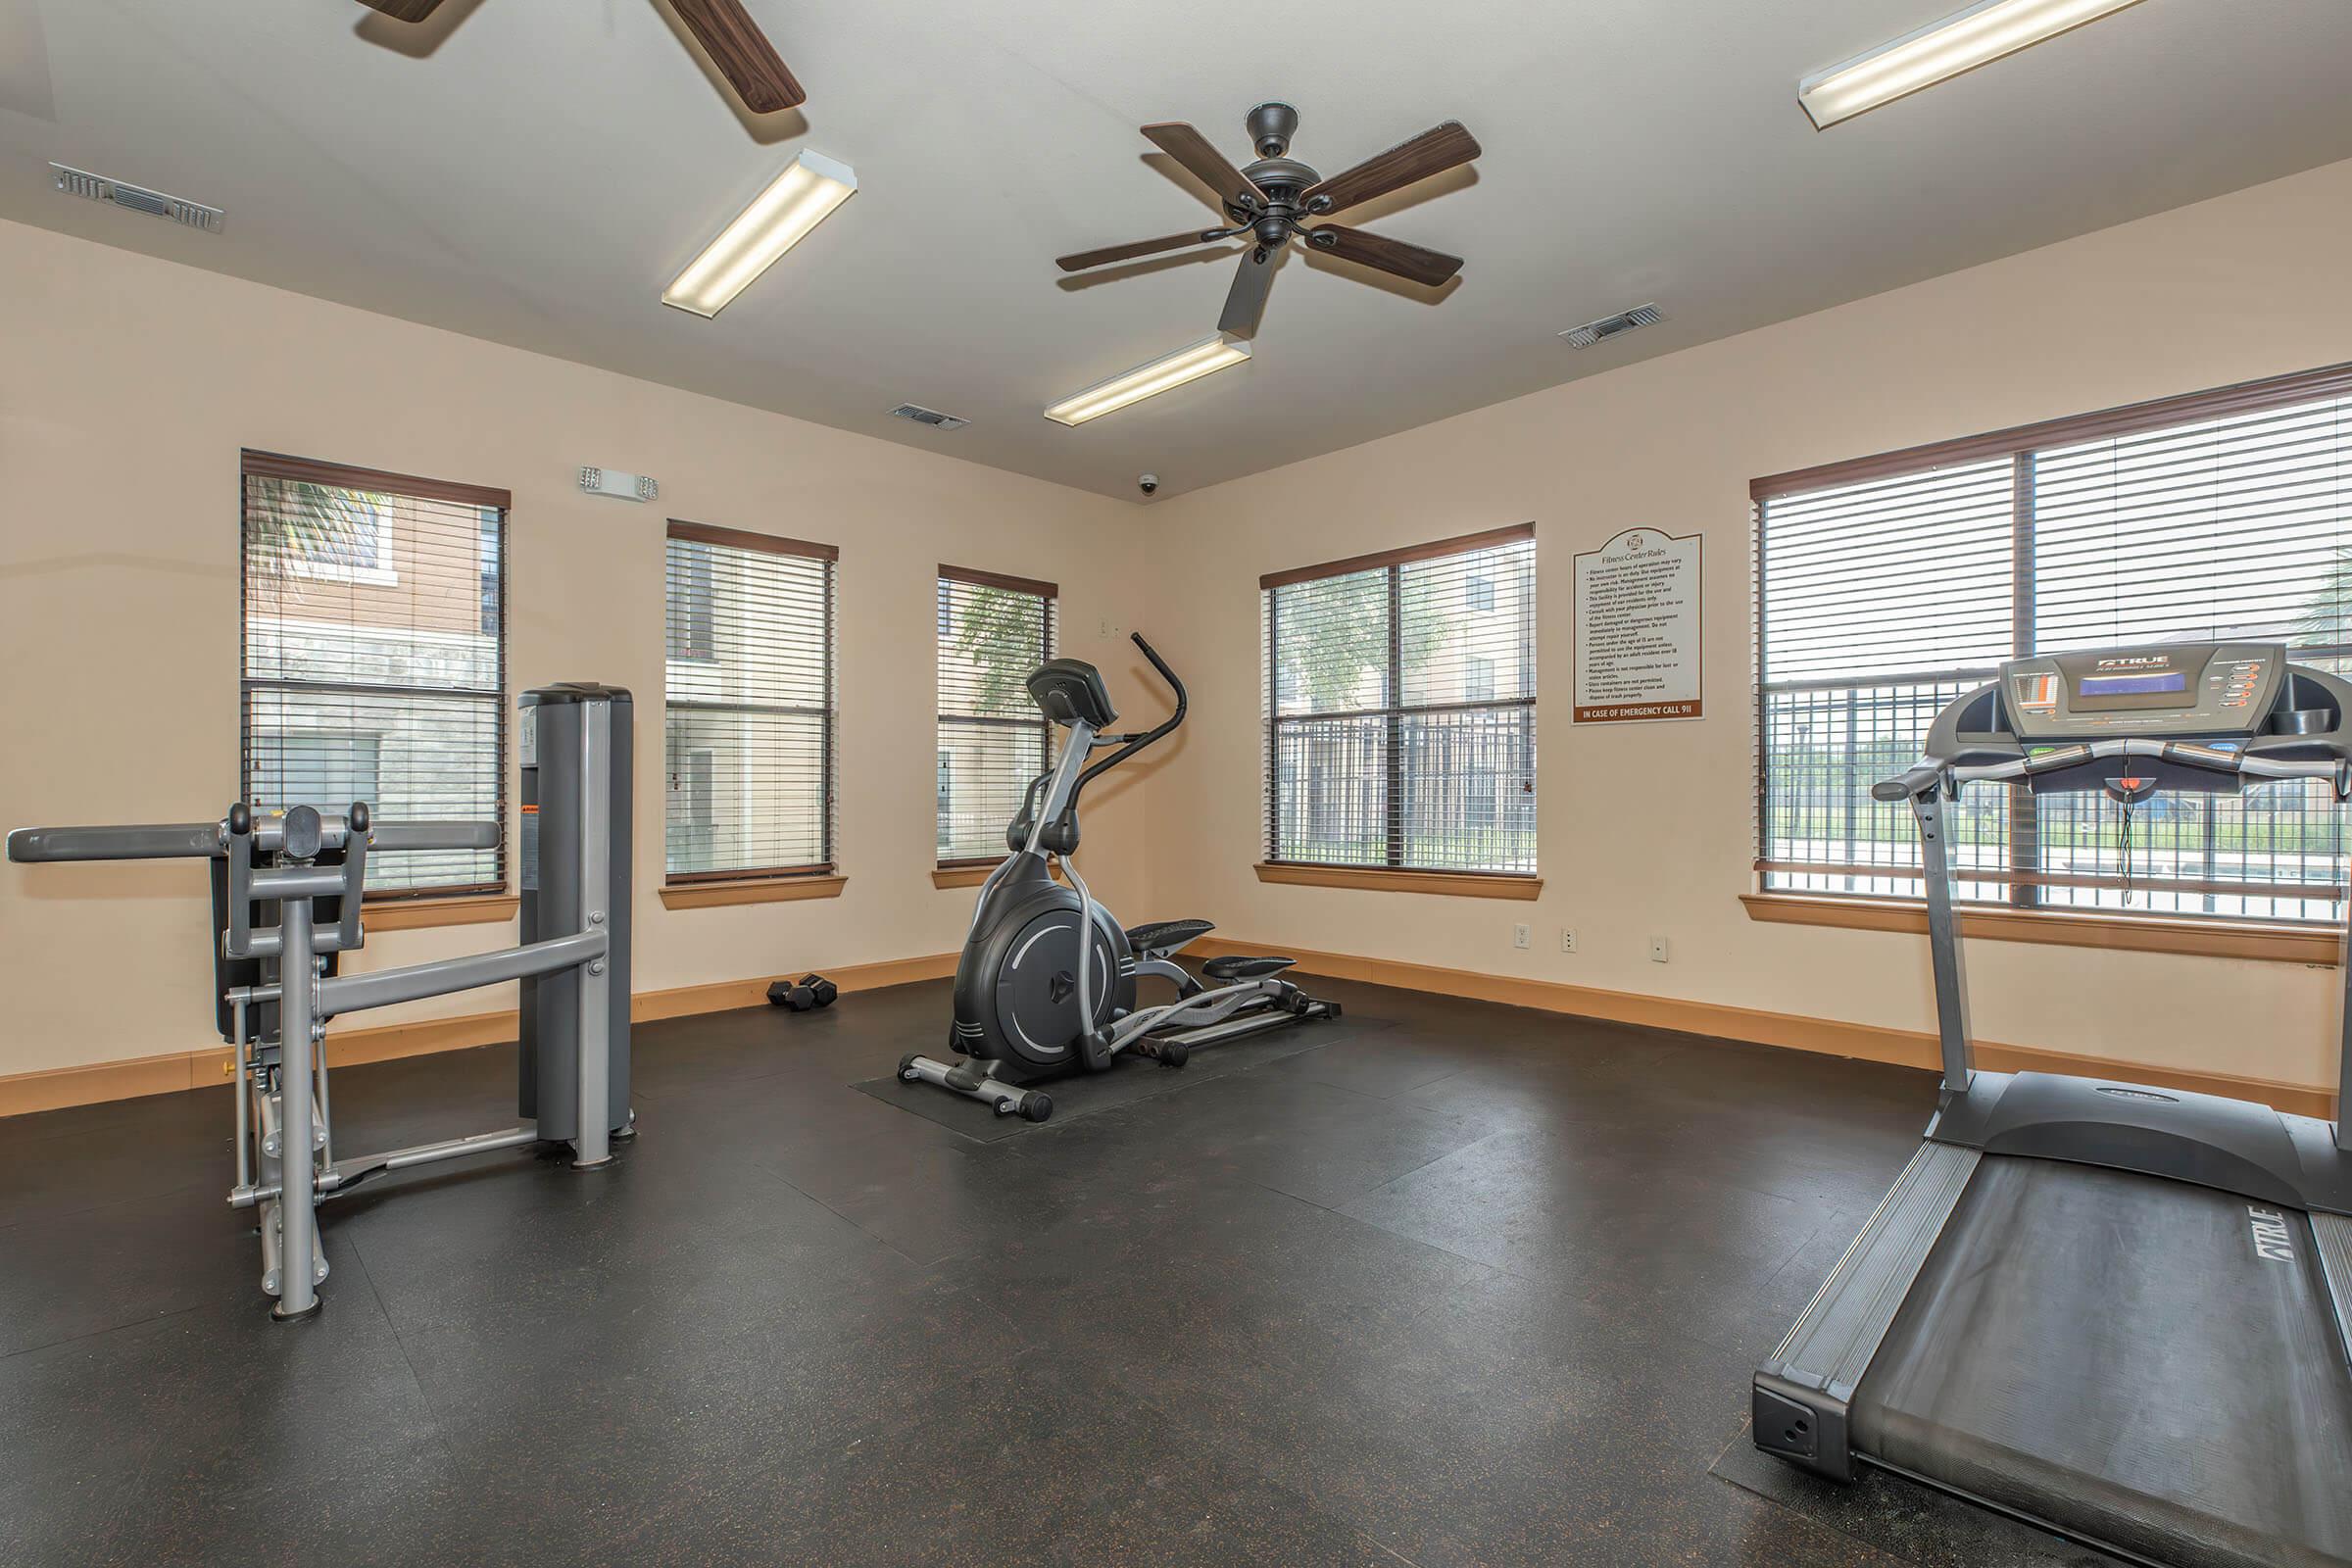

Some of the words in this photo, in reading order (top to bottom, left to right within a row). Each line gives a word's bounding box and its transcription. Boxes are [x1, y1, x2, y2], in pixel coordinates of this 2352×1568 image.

[2117, 656, 2168, 664] TRUE
[1620, 707, 1661, 716] EMERGENCY
[2246, 1205, 2291, 1247] TRUE
